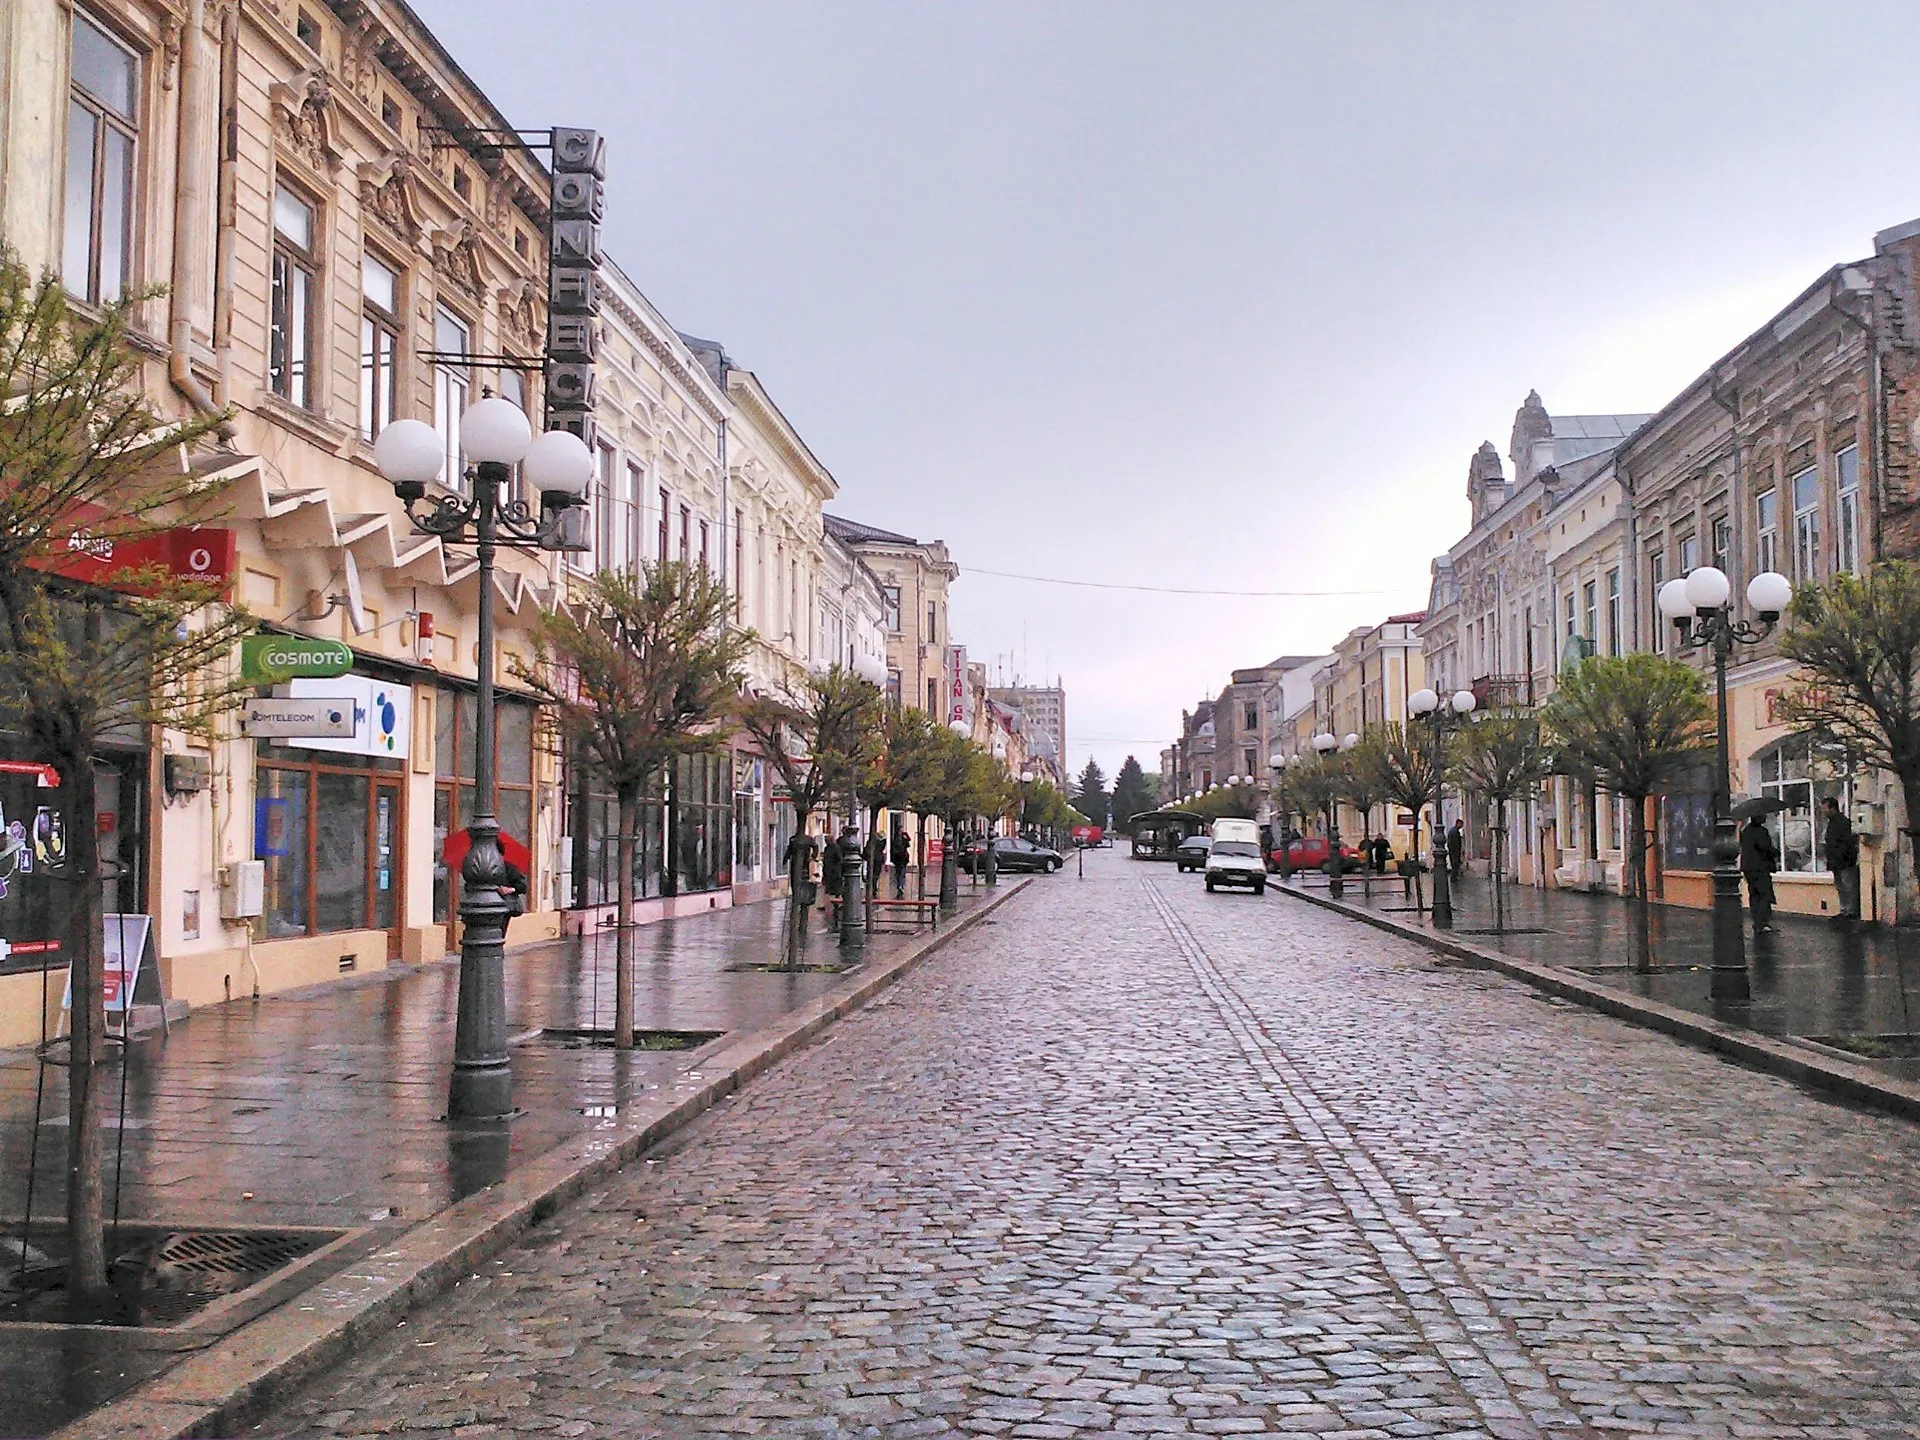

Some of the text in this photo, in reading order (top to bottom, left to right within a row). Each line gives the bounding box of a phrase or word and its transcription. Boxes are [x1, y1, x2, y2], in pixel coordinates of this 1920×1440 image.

[177, 572, 221, 582] vodafone
[267, 651, 345, 666] COSMOTE
[953, 649, 963, 697] TITAN
